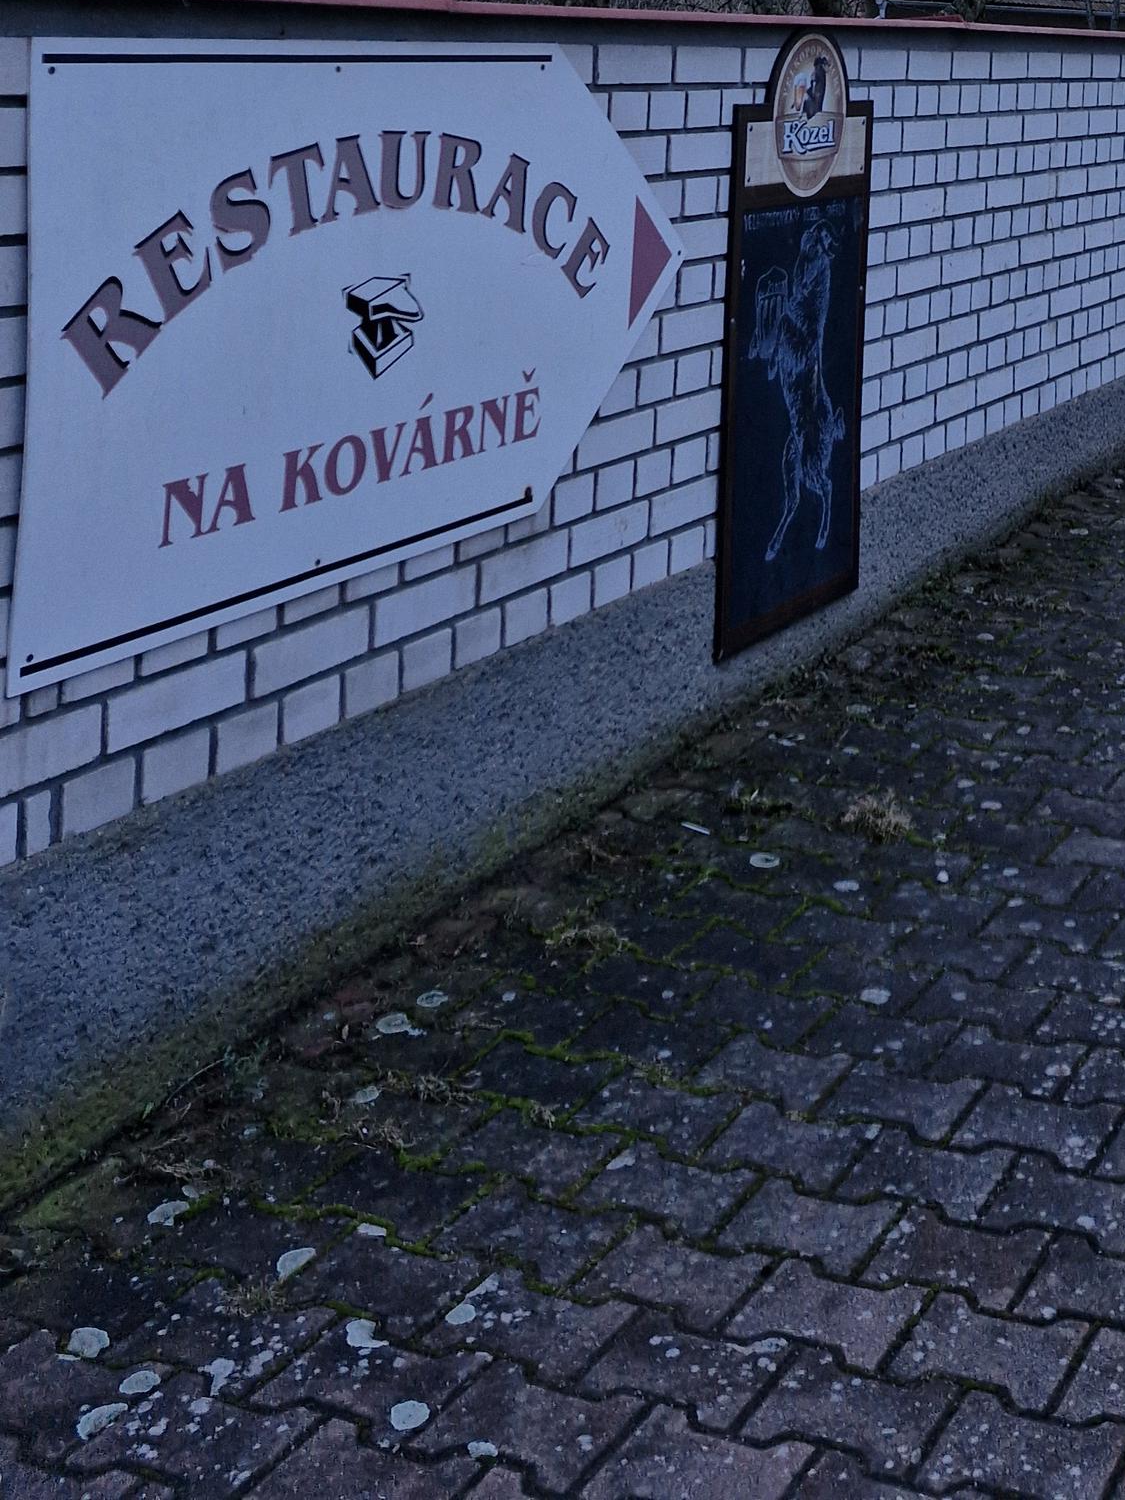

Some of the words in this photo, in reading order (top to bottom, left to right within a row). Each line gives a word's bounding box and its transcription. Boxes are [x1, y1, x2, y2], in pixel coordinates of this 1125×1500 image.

[782, 117, 836, 155] Kozel
[60, 129, 610, 400] RESTAURACE
[157, 464, 256, 548] NA
[278, 367, 542, 514] KOVÁRNĚ
